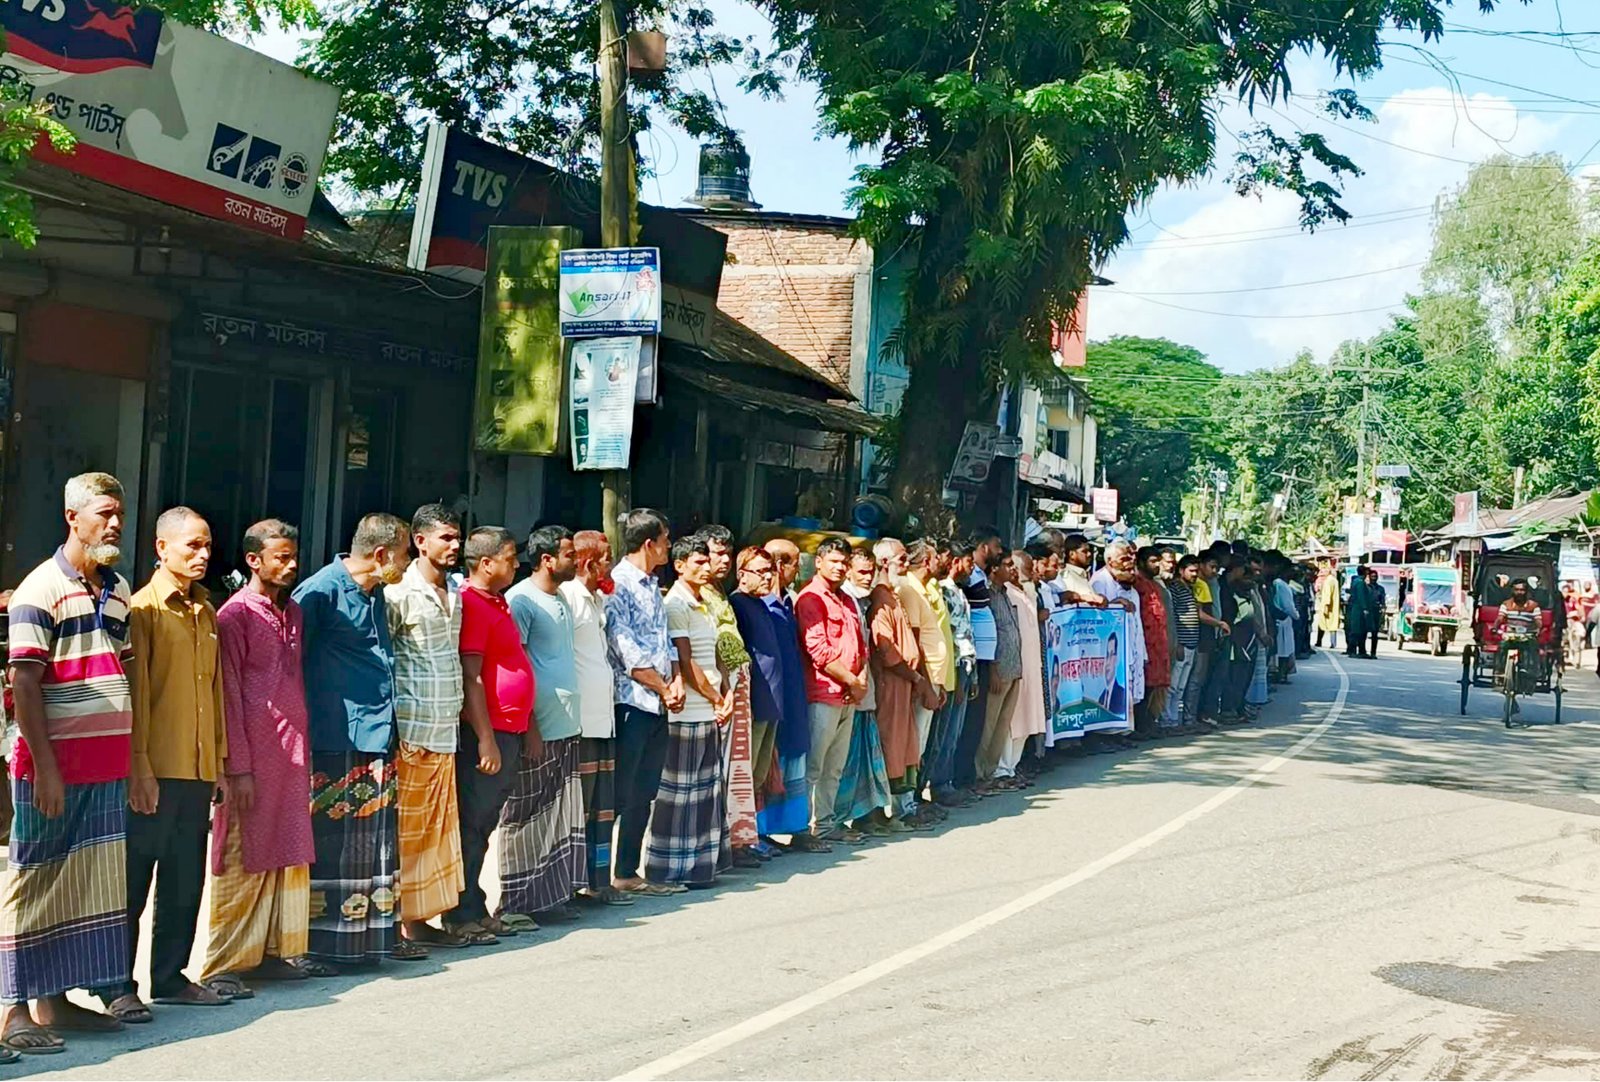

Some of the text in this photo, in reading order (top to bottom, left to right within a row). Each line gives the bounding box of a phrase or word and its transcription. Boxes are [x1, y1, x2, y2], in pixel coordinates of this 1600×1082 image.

[451, 159, 509, 209] TVS
[224, 197, 288, 236] রতন মটরস্
[202, 312, 328, 354] রতন মটরস্
[378, 341, 423, 364] রতন
